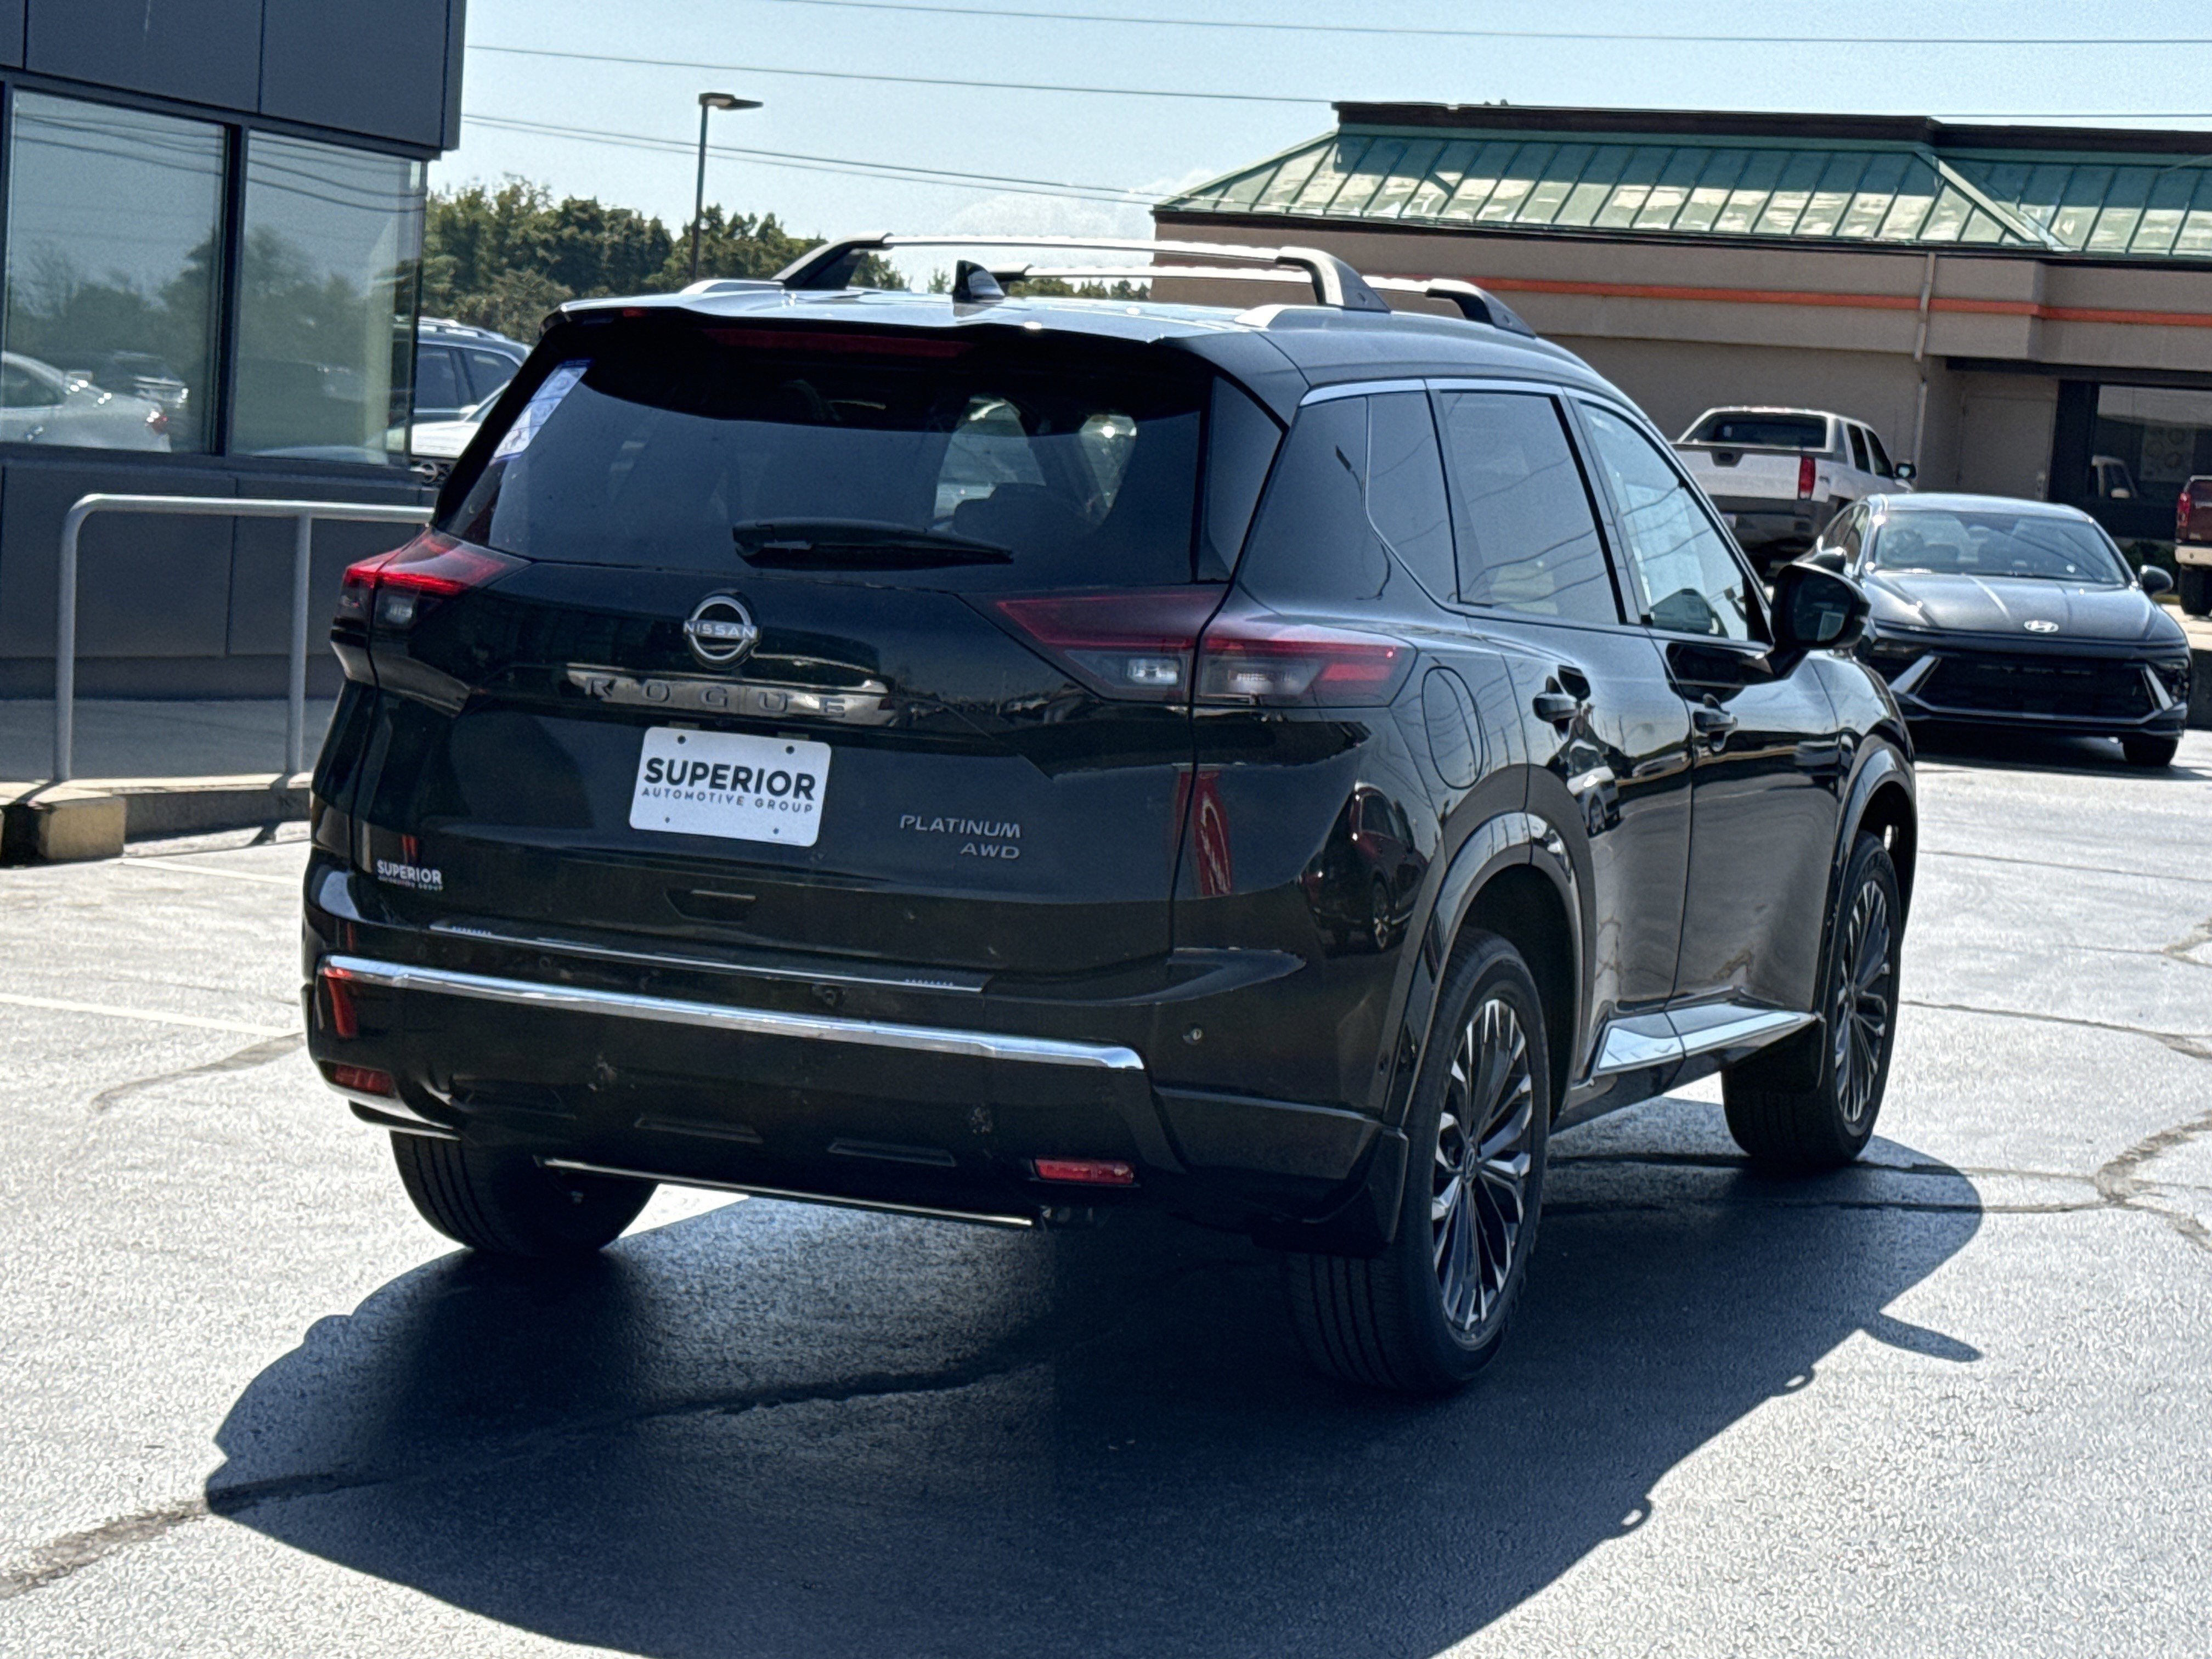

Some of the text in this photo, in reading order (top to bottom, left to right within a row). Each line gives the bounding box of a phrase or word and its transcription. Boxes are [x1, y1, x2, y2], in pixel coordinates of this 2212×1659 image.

[684, 622, 756, 639] NISSAN
[585, 676, 846, 718] ROGUE
[644, 757, 816, 801] SUPERIOR
[642, 787, 813, 814] AUTOMOTIVE GROUP
[900, 814, 1021, 838] PLATINUM
[960, 842, 1020, 859] AWD
[376, 859, 442, 885] SUPERIOR
